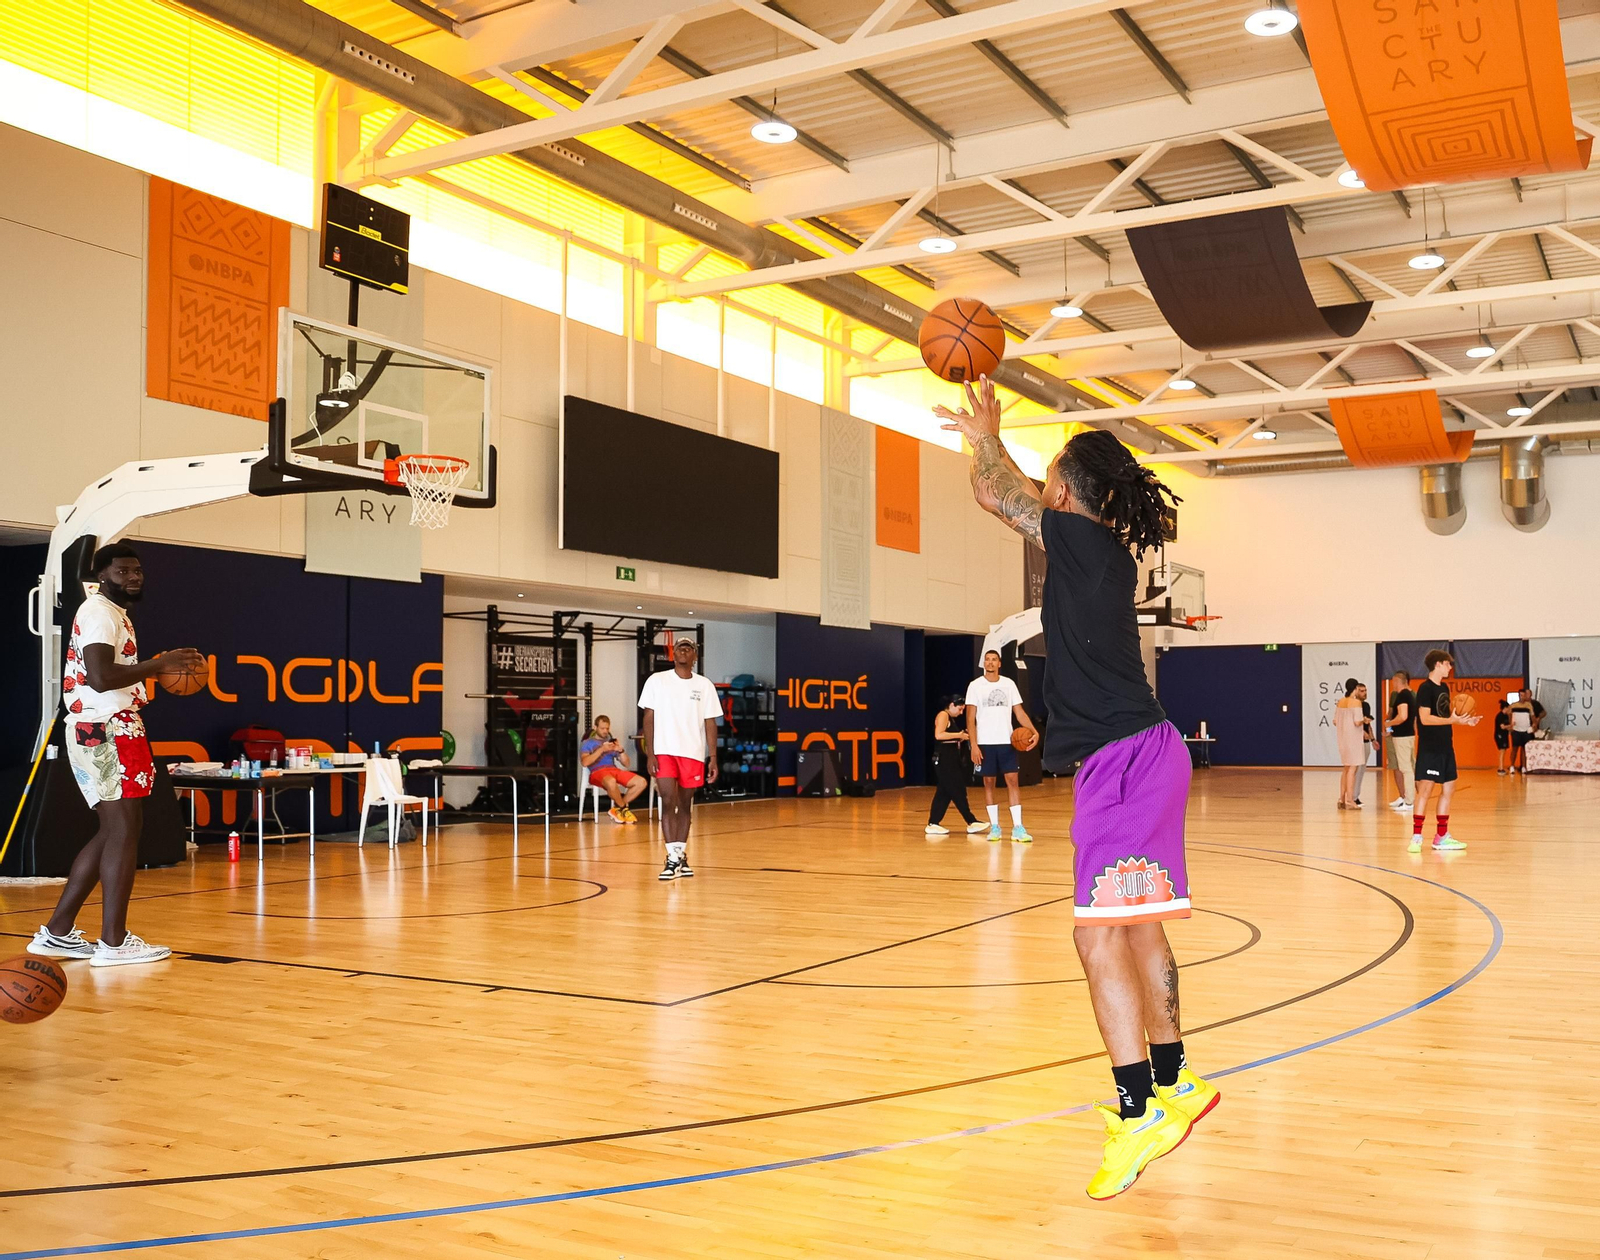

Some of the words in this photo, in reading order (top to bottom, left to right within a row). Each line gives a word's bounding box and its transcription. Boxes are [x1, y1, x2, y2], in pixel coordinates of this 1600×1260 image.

[1418, 24, 1440, 34] THE
[1391, 51, 1487, 91] ARY
[205, 257, 254, 287] NBPA
[1362, 404, 1409, 420] SAN
[1371, 431, 1412, 442] ARY
[335, 496, 396, 524] ARY
[1319, 681, 1345, 695] SA
[1448, 681, 1502, 693] TUARIOS
[1566, 678, 1594, 691] AN
[1565, 713, 1593, 726] RY
